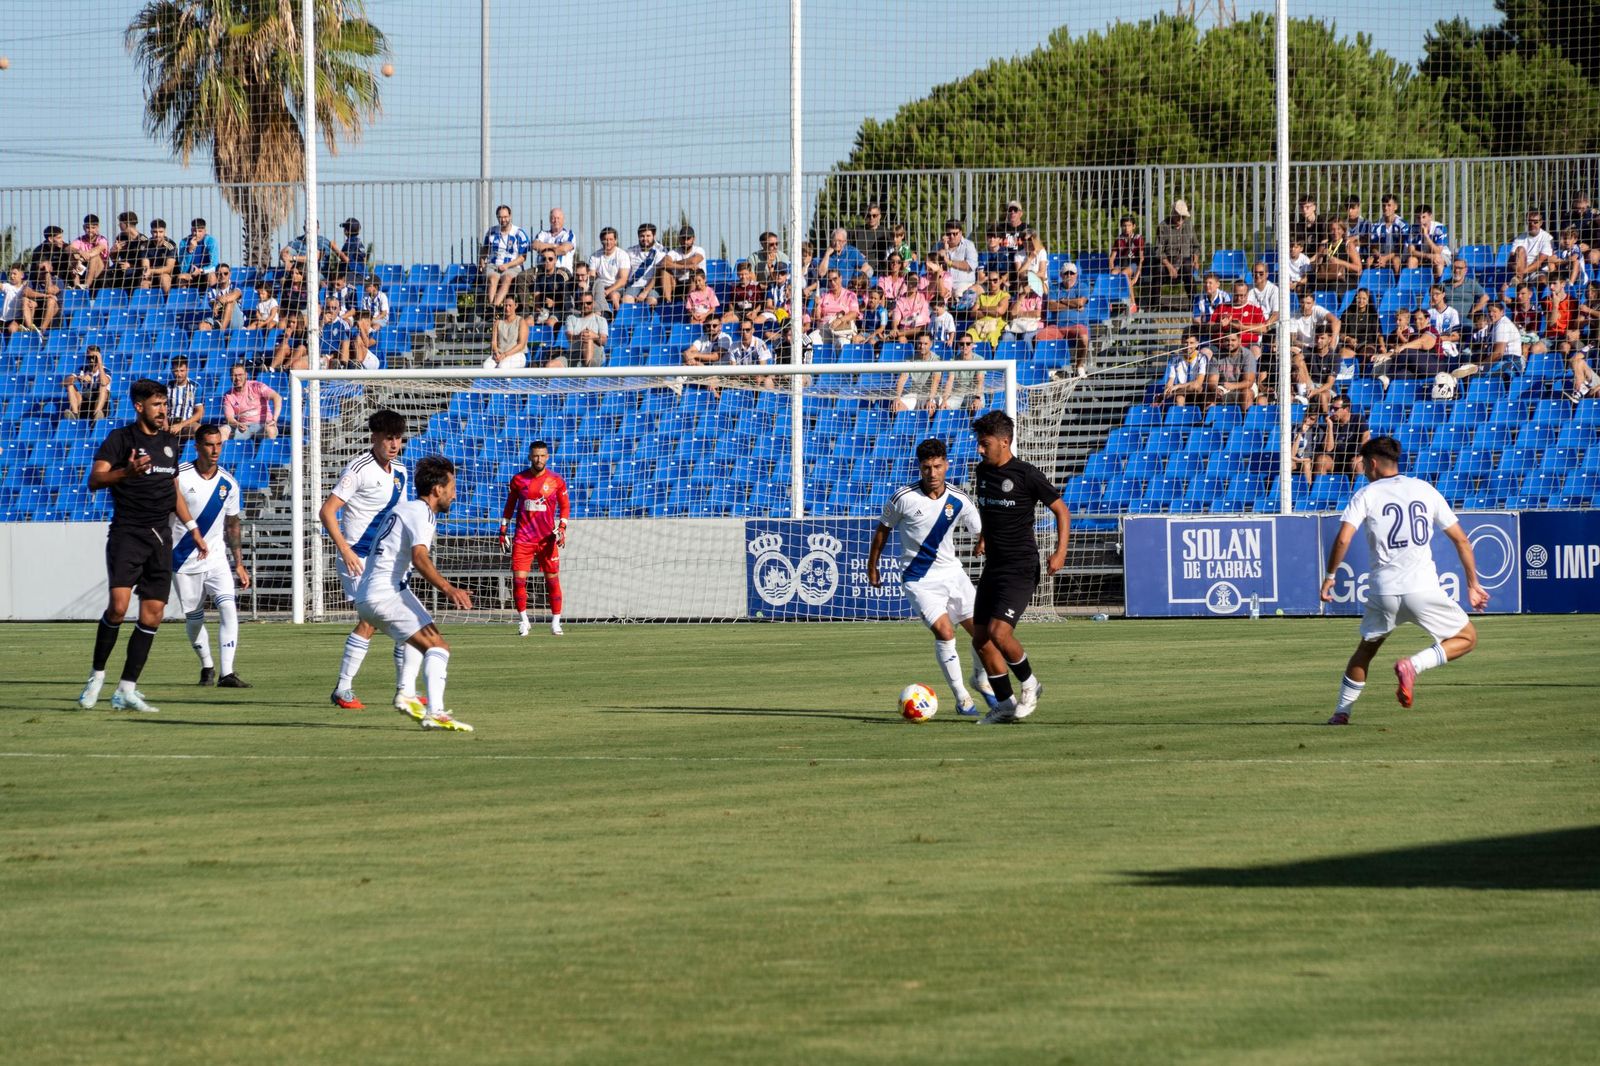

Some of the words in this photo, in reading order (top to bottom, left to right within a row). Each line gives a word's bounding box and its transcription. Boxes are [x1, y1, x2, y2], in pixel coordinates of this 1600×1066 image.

[1382, 500, 1429, 550] 26
[1183, 561, 1201, 579] DE
[1206, 560, 1262, 579] CABRAS
[1554, 544, 1600, 579] IMP
[1526, 568, 1548, 577] TERCERA
[865, 585, 906, 597] HUELV
